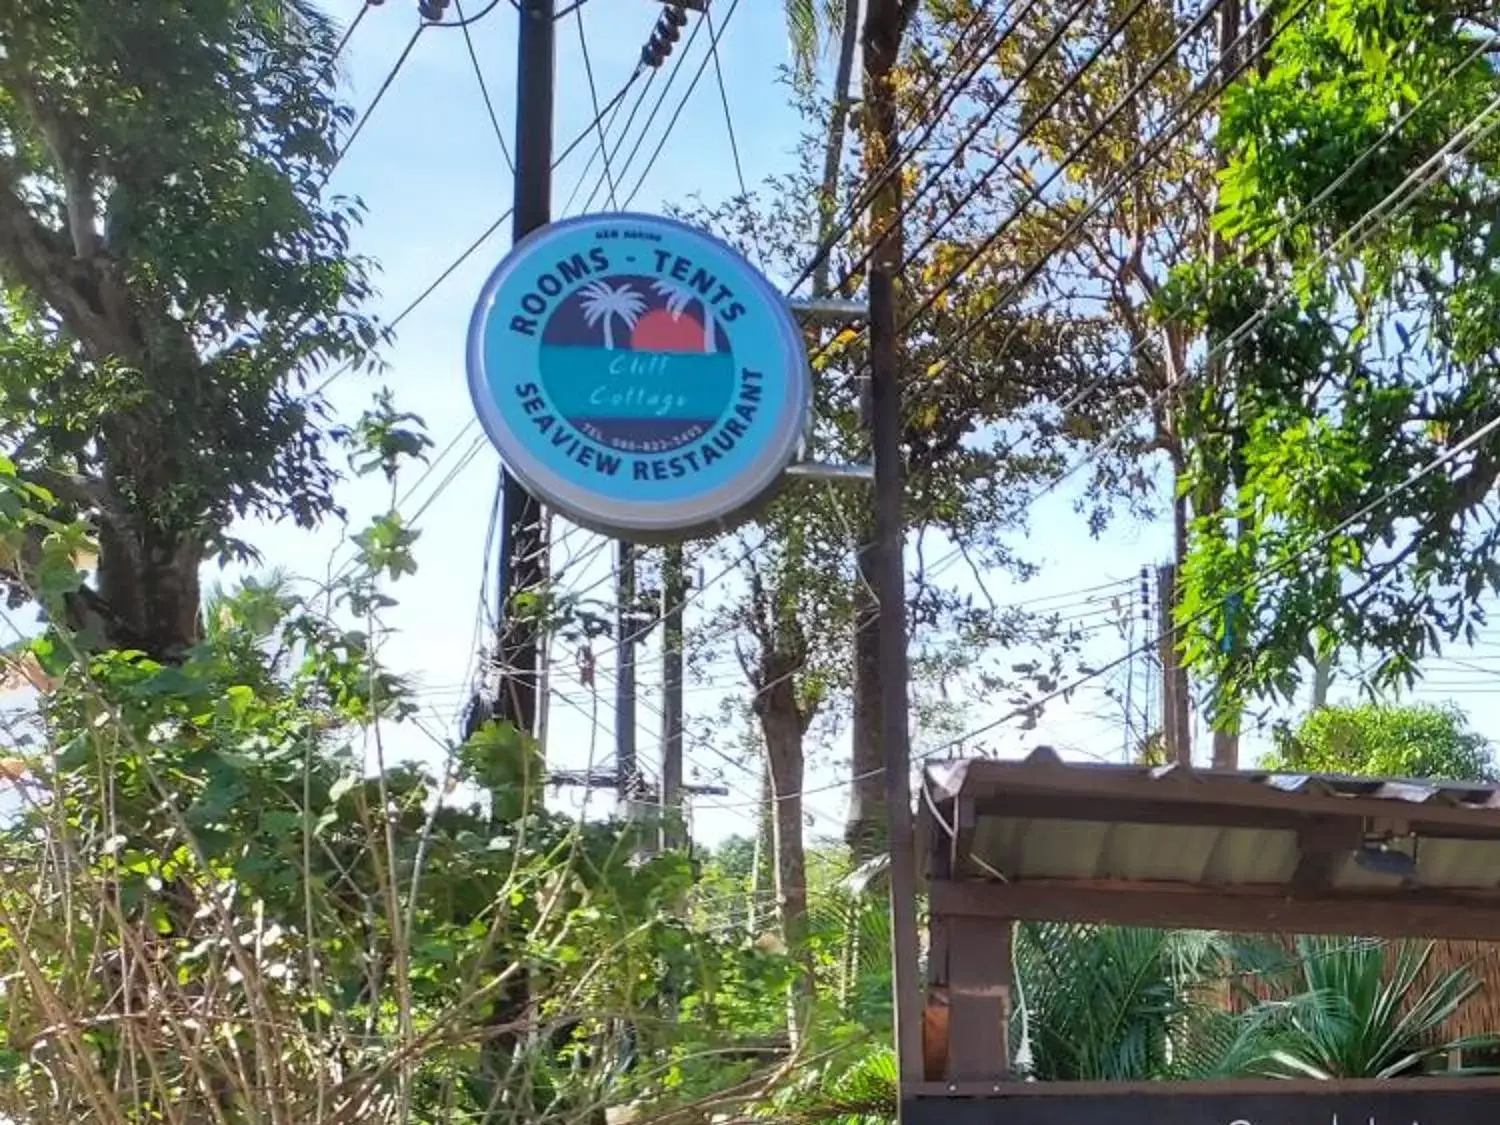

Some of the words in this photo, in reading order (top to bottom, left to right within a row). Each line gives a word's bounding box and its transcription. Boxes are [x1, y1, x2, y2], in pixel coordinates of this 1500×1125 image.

[510, 246, 609, 336] ROOMS
[653, 248, 747, 322] TENTS
[609, 353, 670, 375] Cliff
[514, 382, 622, 477] SEAVIEW
[632, 368, 763, 481] RESTAURANT
[590, 386, 688, 415] Cottage
